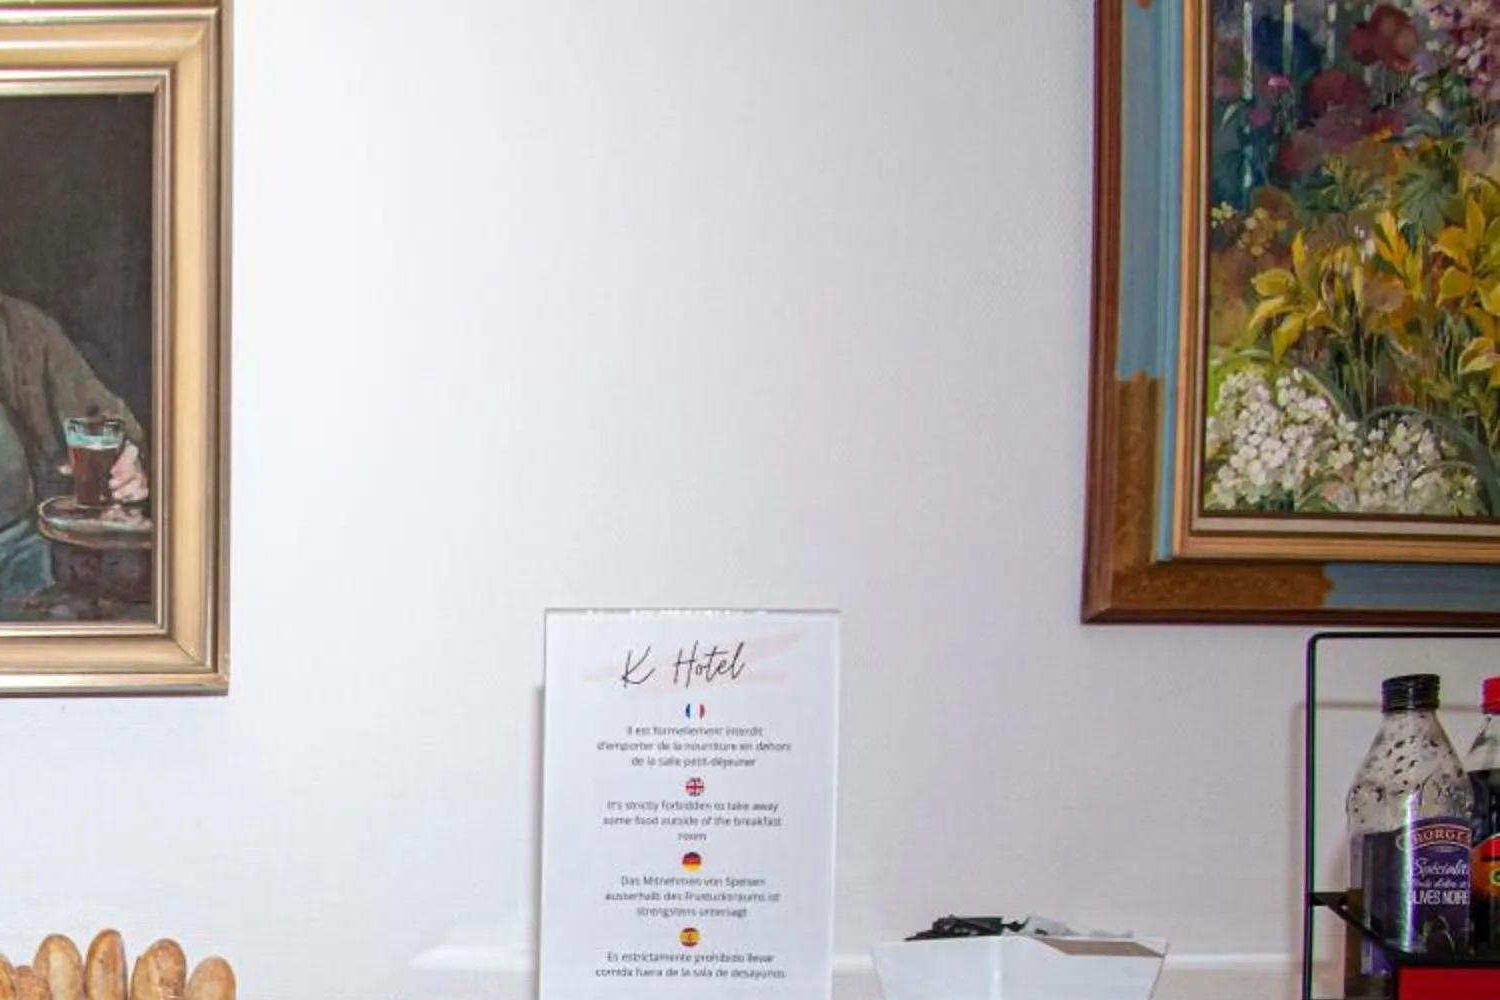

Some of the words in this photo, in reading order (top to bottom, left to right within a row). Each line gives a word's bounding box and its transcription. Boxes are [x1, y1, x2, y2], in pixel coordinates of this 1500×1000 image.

[621, 645, 656, 688] K
[673, 640, 746, 689] Hotel
[657, 742, 670, 751] de
[673, 742, 682, 751] la
[755, 742, 791, 752] dehors
[631, 757, 644, 766] de
[646, 757, 655, 766] la
[661, 800, 712, 811] forbidden
[727, 800, 750, 811] take
[751, 802, 779, 813] away
[603, 817, 632, 825] some
[634, 816, 658, 825] food
[660, 816, 698, 826] outside
[701, 816, 712, 826] of
[714, 816, 731, 826] the
[733, 816, 781, 827] breakfast
[621, 876, 639, 886] Das
[704, 878, 722, 886] von
[1411, 889, 1441, 904] LIVES
[607, 952, 618, 962] Es
[596, 967, 633, 977] comida
[665, 967, 679, 977] de
[681, 967, 690, 977] la
[692, 967, 713, 977] sala
[715, 967, 728, 977] de
